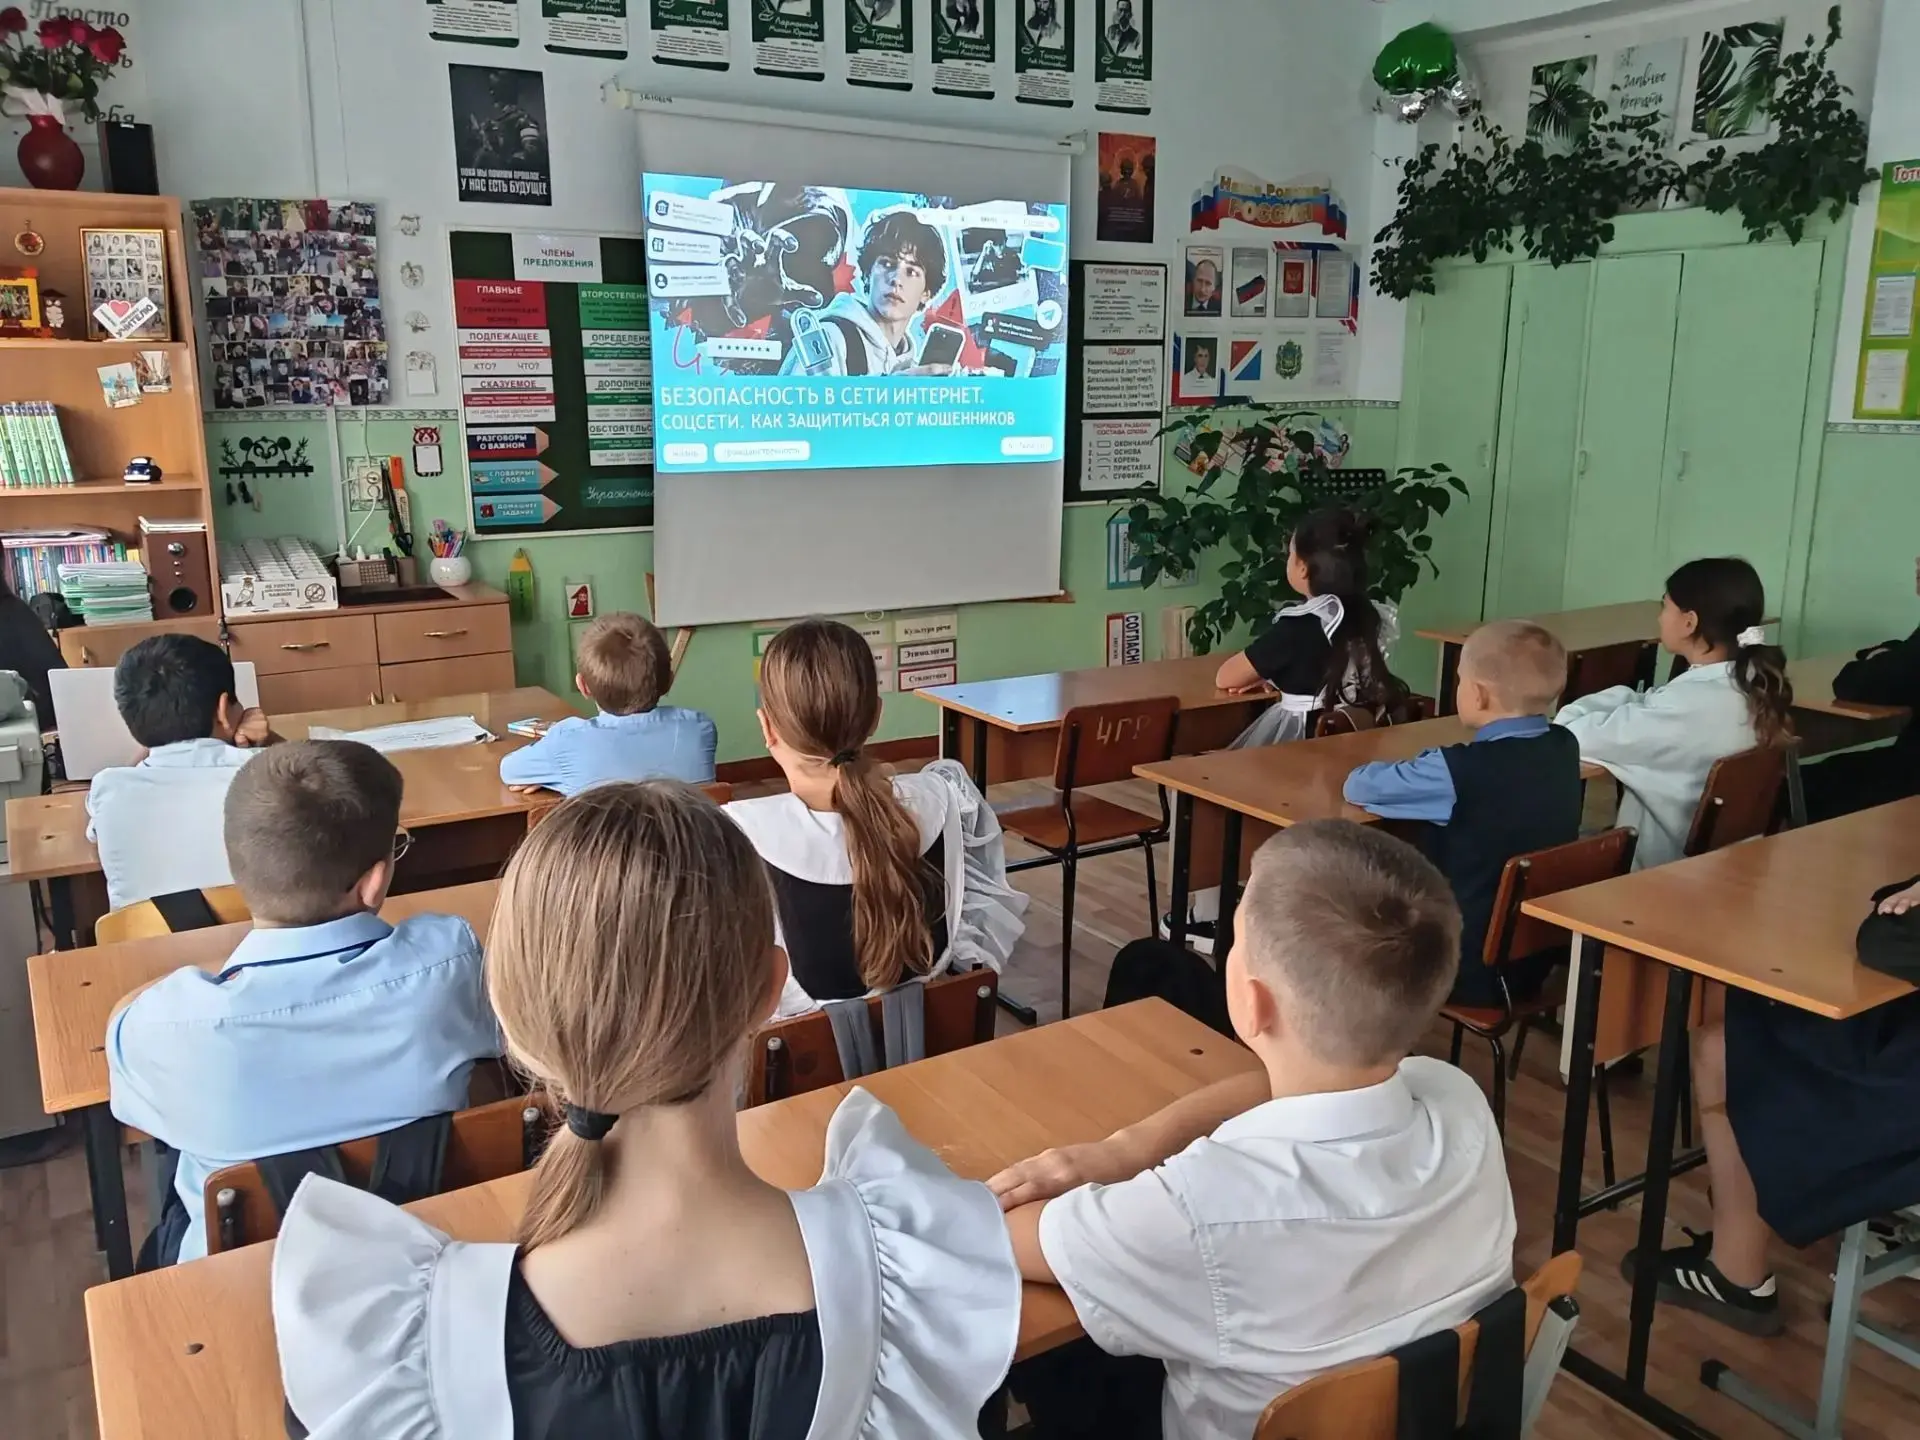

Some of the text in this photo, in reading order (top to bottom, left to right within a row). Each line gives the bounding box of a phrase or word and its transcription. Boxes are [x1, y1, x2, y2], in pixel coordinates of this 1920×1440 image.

[461, 178, 547, 195] У НАС ЕСТЬ БУДУЩЕЕ
[541, 249, 575, 257] ЧЛЕНЫ
[523, 258, 593, 267] ПРЕДЛОЖЕНИЯ
[476, 285, 523, 294] ГЛАВНЫЕ
[469, 332, 539, 341] ПОДЛЕЖАЩЕЕ
[474, 362, 540, 370] КТО? ЧТО?
[480, 380, 537, 388] СКАЗУЕМОЕ
[660, 386, 985, 406] БЕЗОПАСНОСТЬ В СЕТИ ИНТЕРНЕТ.
[662, 411, 1016, 432] СОЦСЕТИ. КАК ЗАЩИТИТЬСЯ ОТ МОШЕННИКОВ
[476, 434, 527, 442] РАЗГОВОРЫ
[904, 624, 951, 636] Культура речи
[904, 646, 950, 659] Этимология
[908, 671, 948, 683] Стилистика
